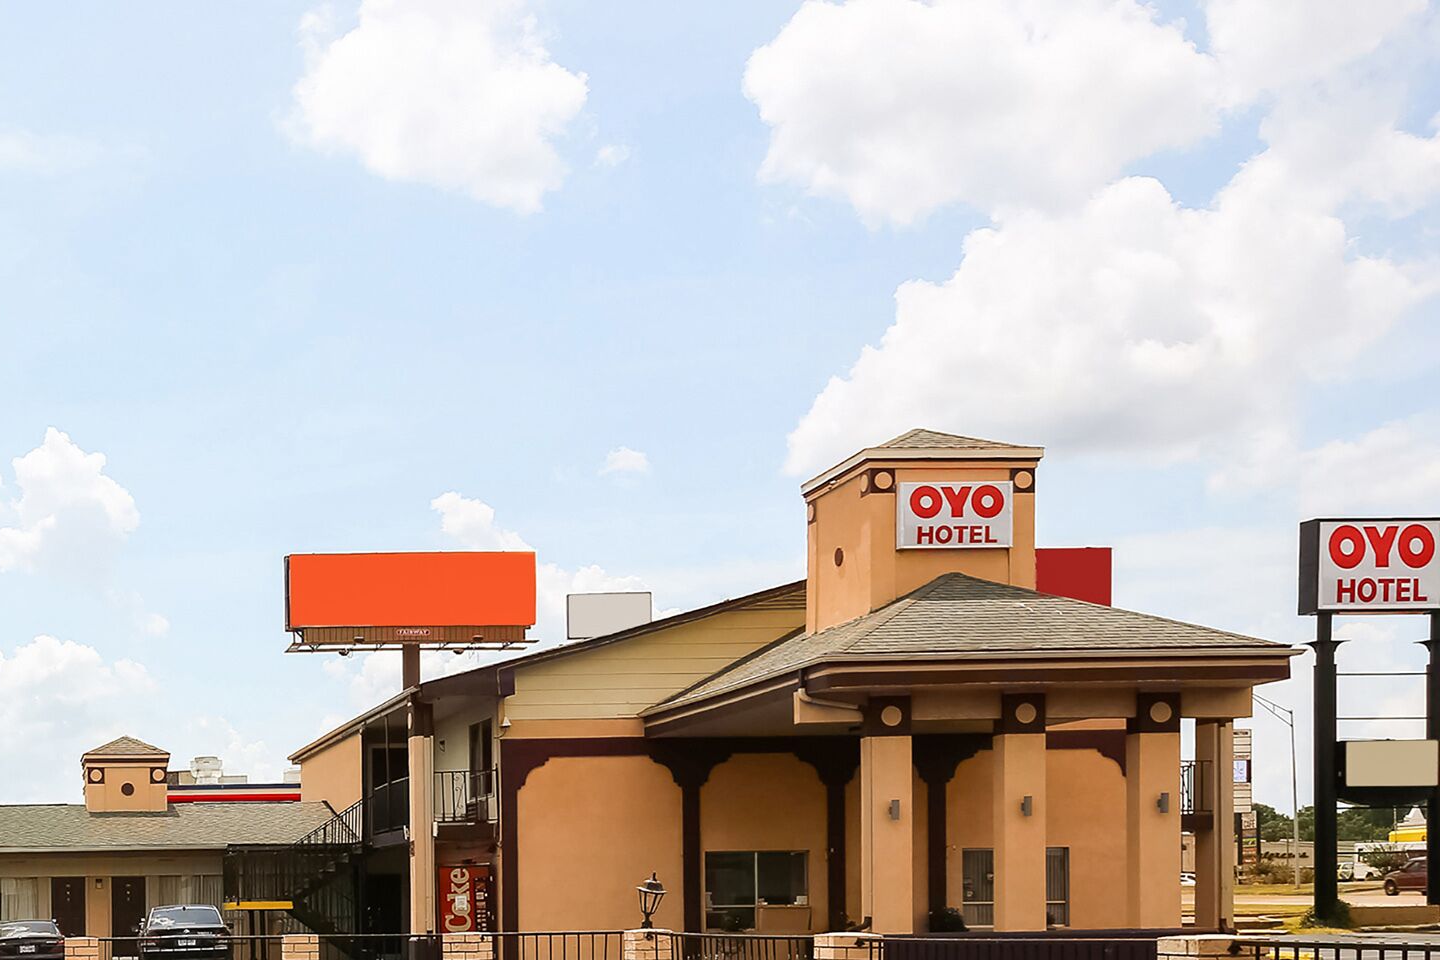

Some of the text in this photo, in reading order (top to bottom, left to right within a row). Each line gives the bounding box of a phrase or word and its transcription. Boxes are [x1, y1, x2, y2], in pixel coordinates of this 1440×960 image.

[909, 484, 1005, 519] OYO
[916, 525, 998, 545] HOTEL
[1328, 523, 1436, 570] OYO
[1336, 577, 1428, 604] HOTEL
